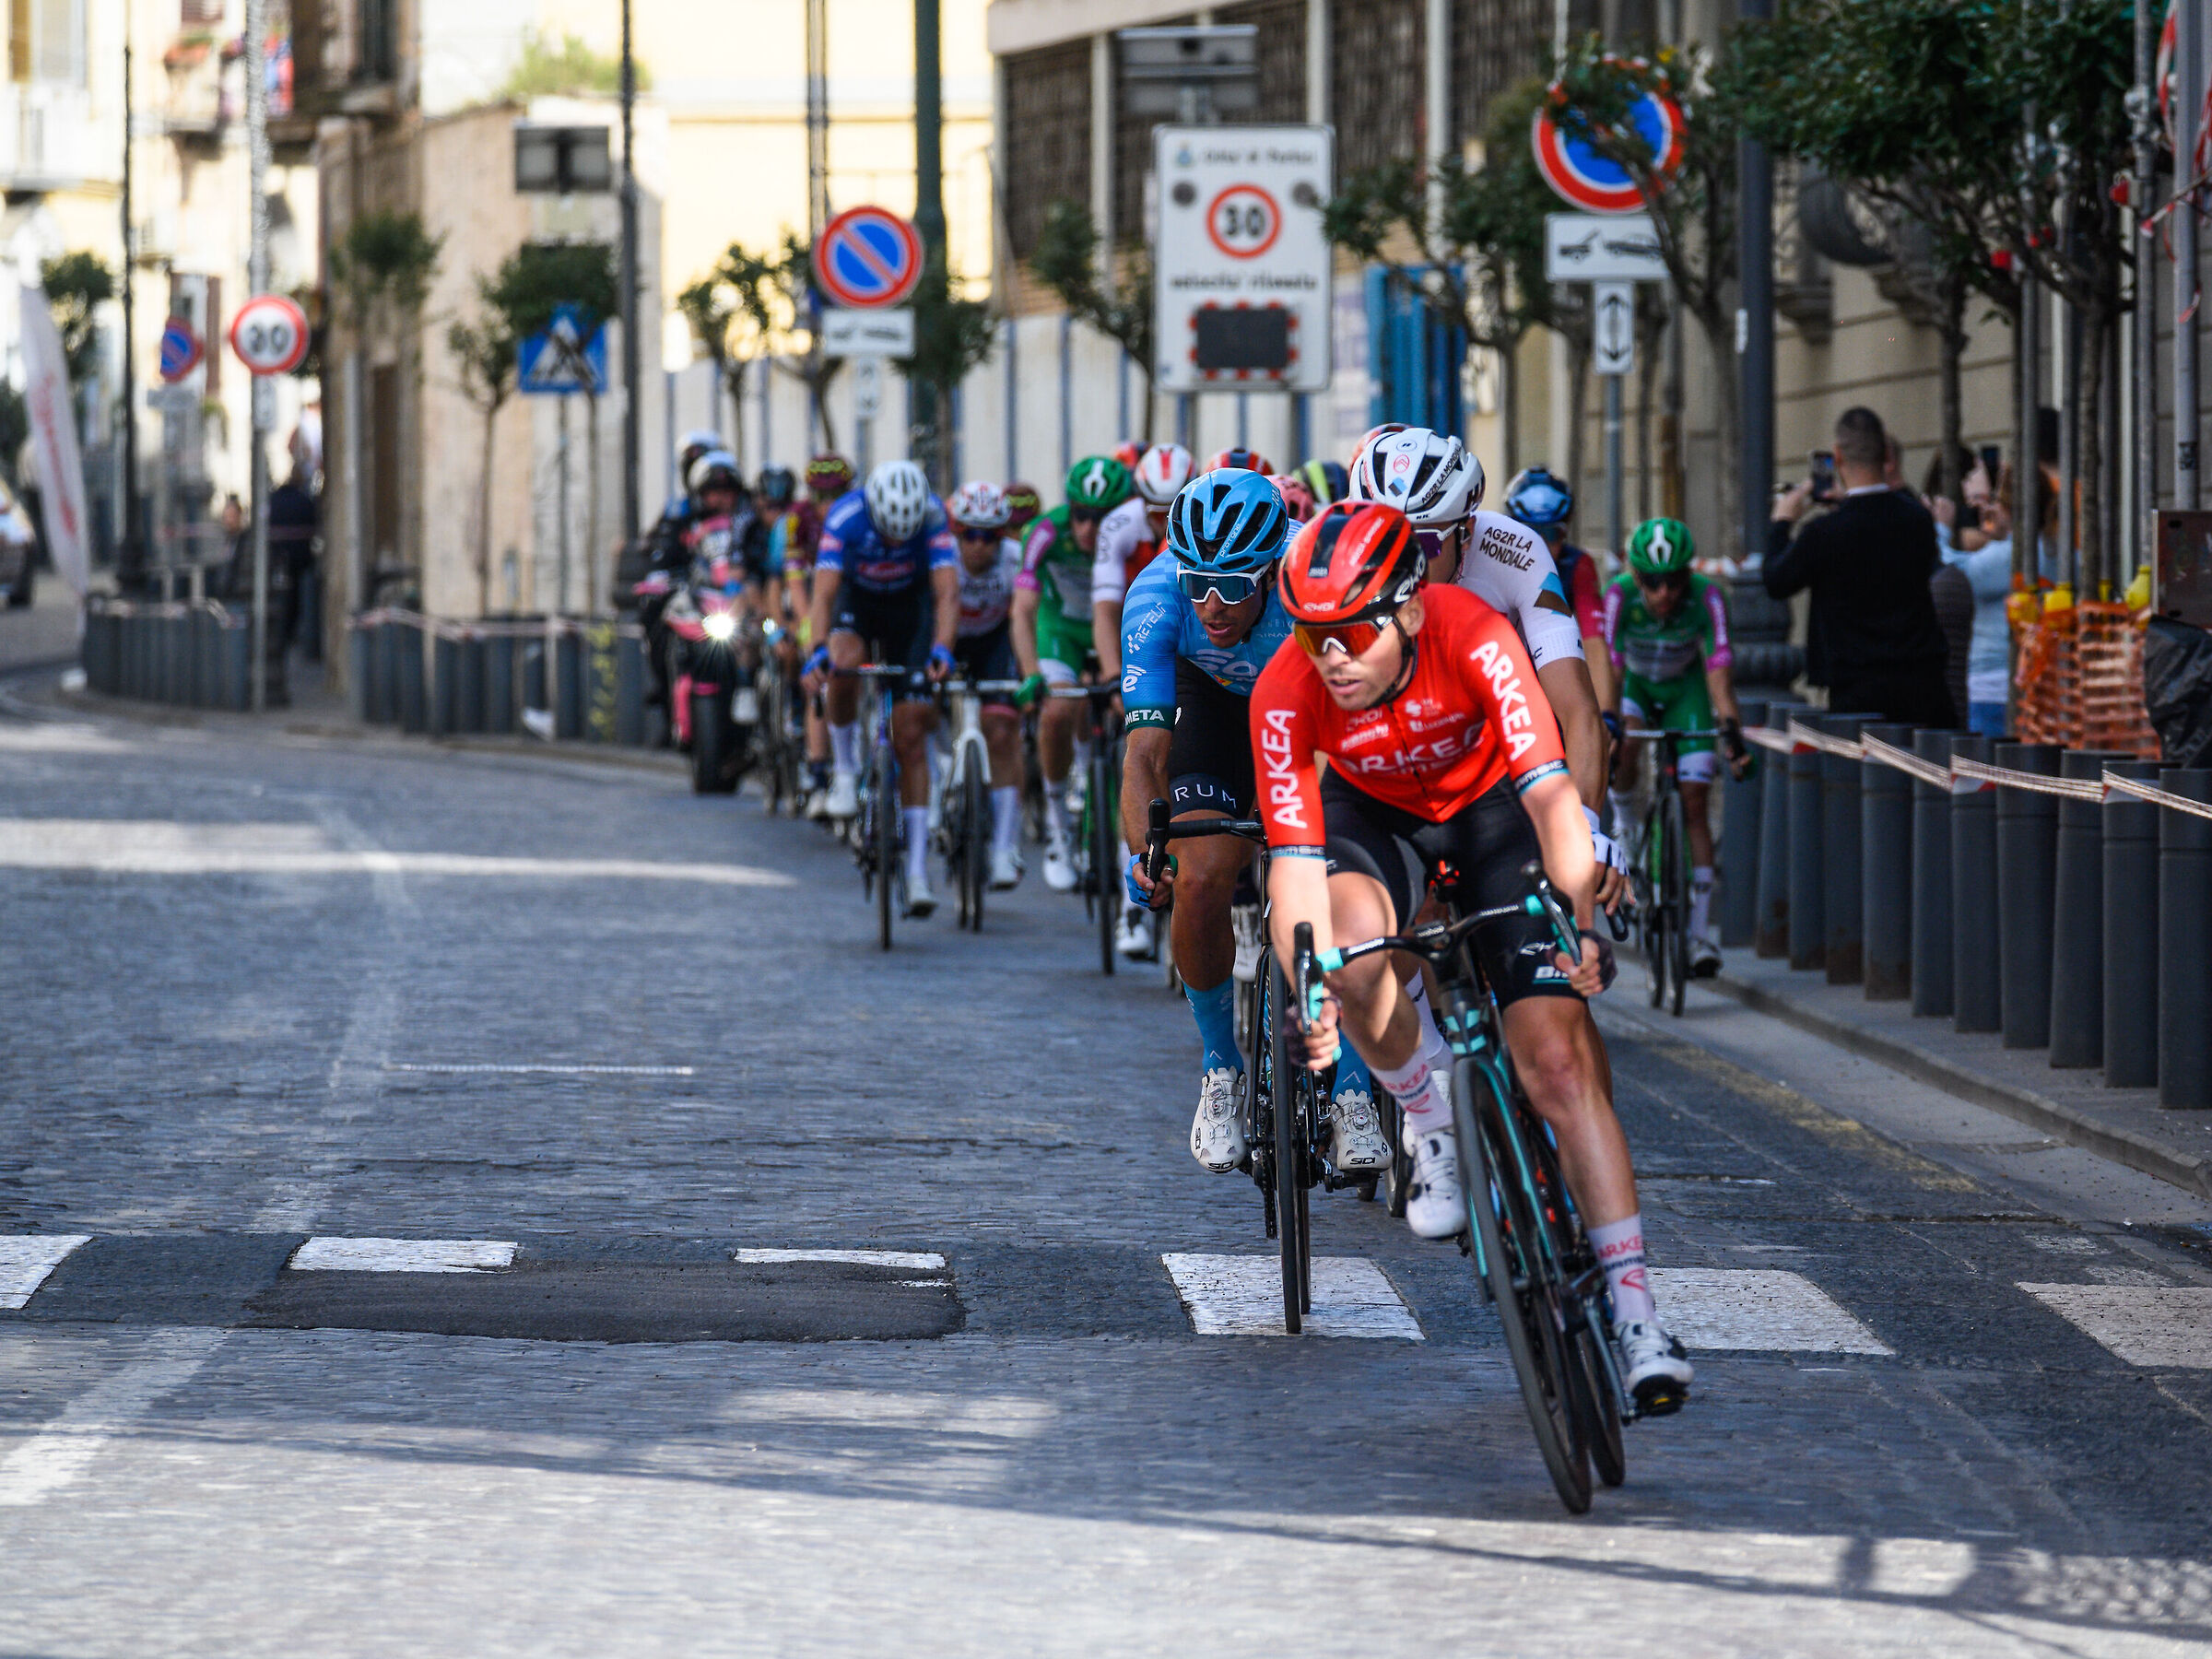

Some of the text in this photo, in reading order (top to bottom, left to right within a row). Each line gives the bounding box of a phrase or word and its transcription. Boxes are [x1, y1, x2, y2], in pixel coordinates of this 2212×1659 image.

[1223, 204, 1266, 239] 30
[249, 323, 291, 354] 30
[1478, 537, 1535, 572] MONDIALE
[1484, 526, 1534, 553] AG2R LA
[1469, 640, 1537, 762] ARKEA
[1261, 709, 1309, 830] ARKEA
